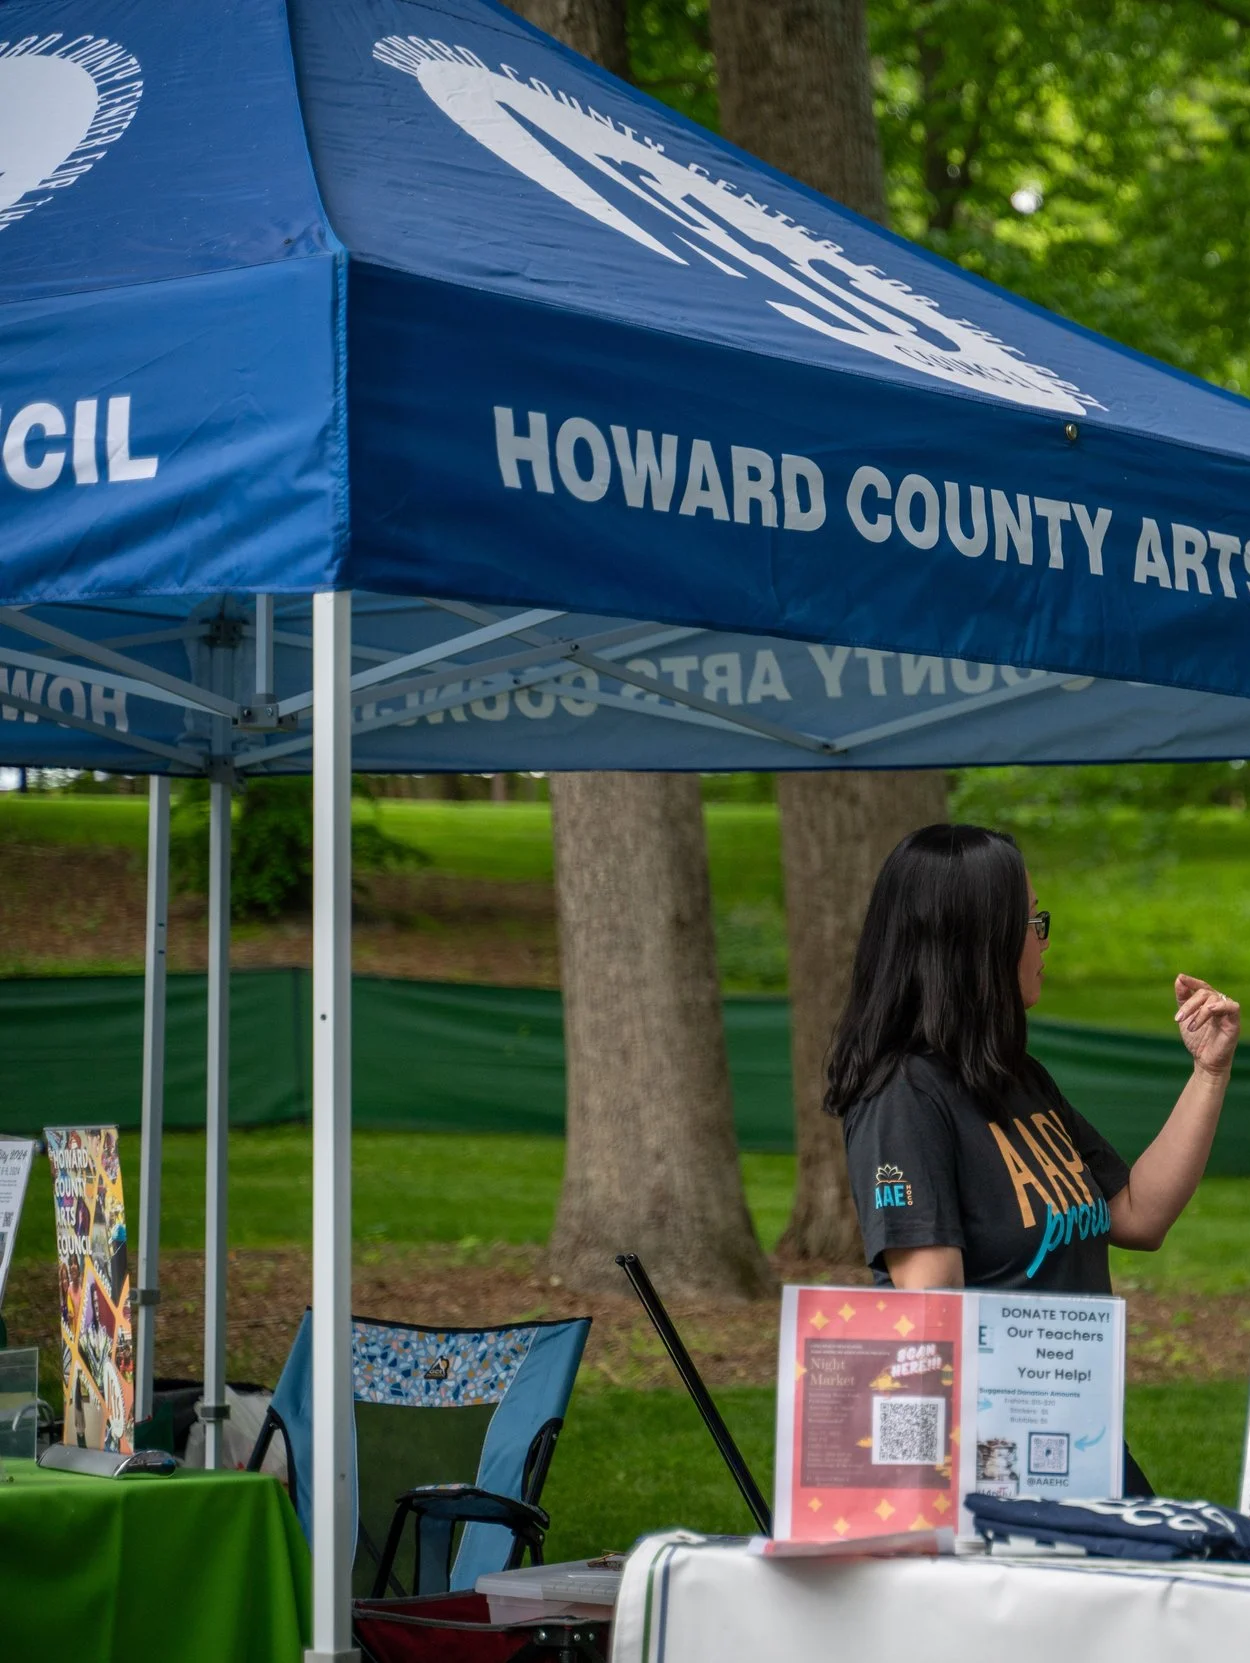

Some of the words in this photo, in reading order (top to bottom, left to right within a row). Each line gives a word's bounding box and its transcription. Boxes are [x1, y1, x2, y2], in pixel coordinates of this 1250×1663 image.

[97, 80, 144, 150] CENTER
[37, 150, 108, 190] FOR
[493, 405, 827, 532] HOWARD
[846, 465, 1113, 576] COUNTY
[53, 1148, 89, 1169] HOWARD
[988, 1109, 1092, 1229] AAP
[55, 1177, 87, 1198] COUNTY
[875, 1185, 906, 1210] AAE
[57, 1206, 77, 1227] ARTS
[58, 1235, 93, 1255] COUNCIL
[1001, 1307, 1056, 1320] DONATE
[1060, 1310, 1110, 1323] TODAY!
[1007, 1326, 1033, 1339] Our
[1037, 1327, 1104, 1342] Teachers
[810, 1357, 846, 1371] Night
[1036, 1348, 1074, 1361] Need
[809, 1374, 855, 1386] Market
[1017, 1367, 1051, 1380] Your
[1055, 1368, 1092, 1383] Help!
[979, 1387, 1016, 1397] Suggested
[1018, 1389, 1049, 1397] Donation
[1050, 1390, 1081, 1398] Amounts
[1026, 1477, 1069, 1487] @AAEHC
